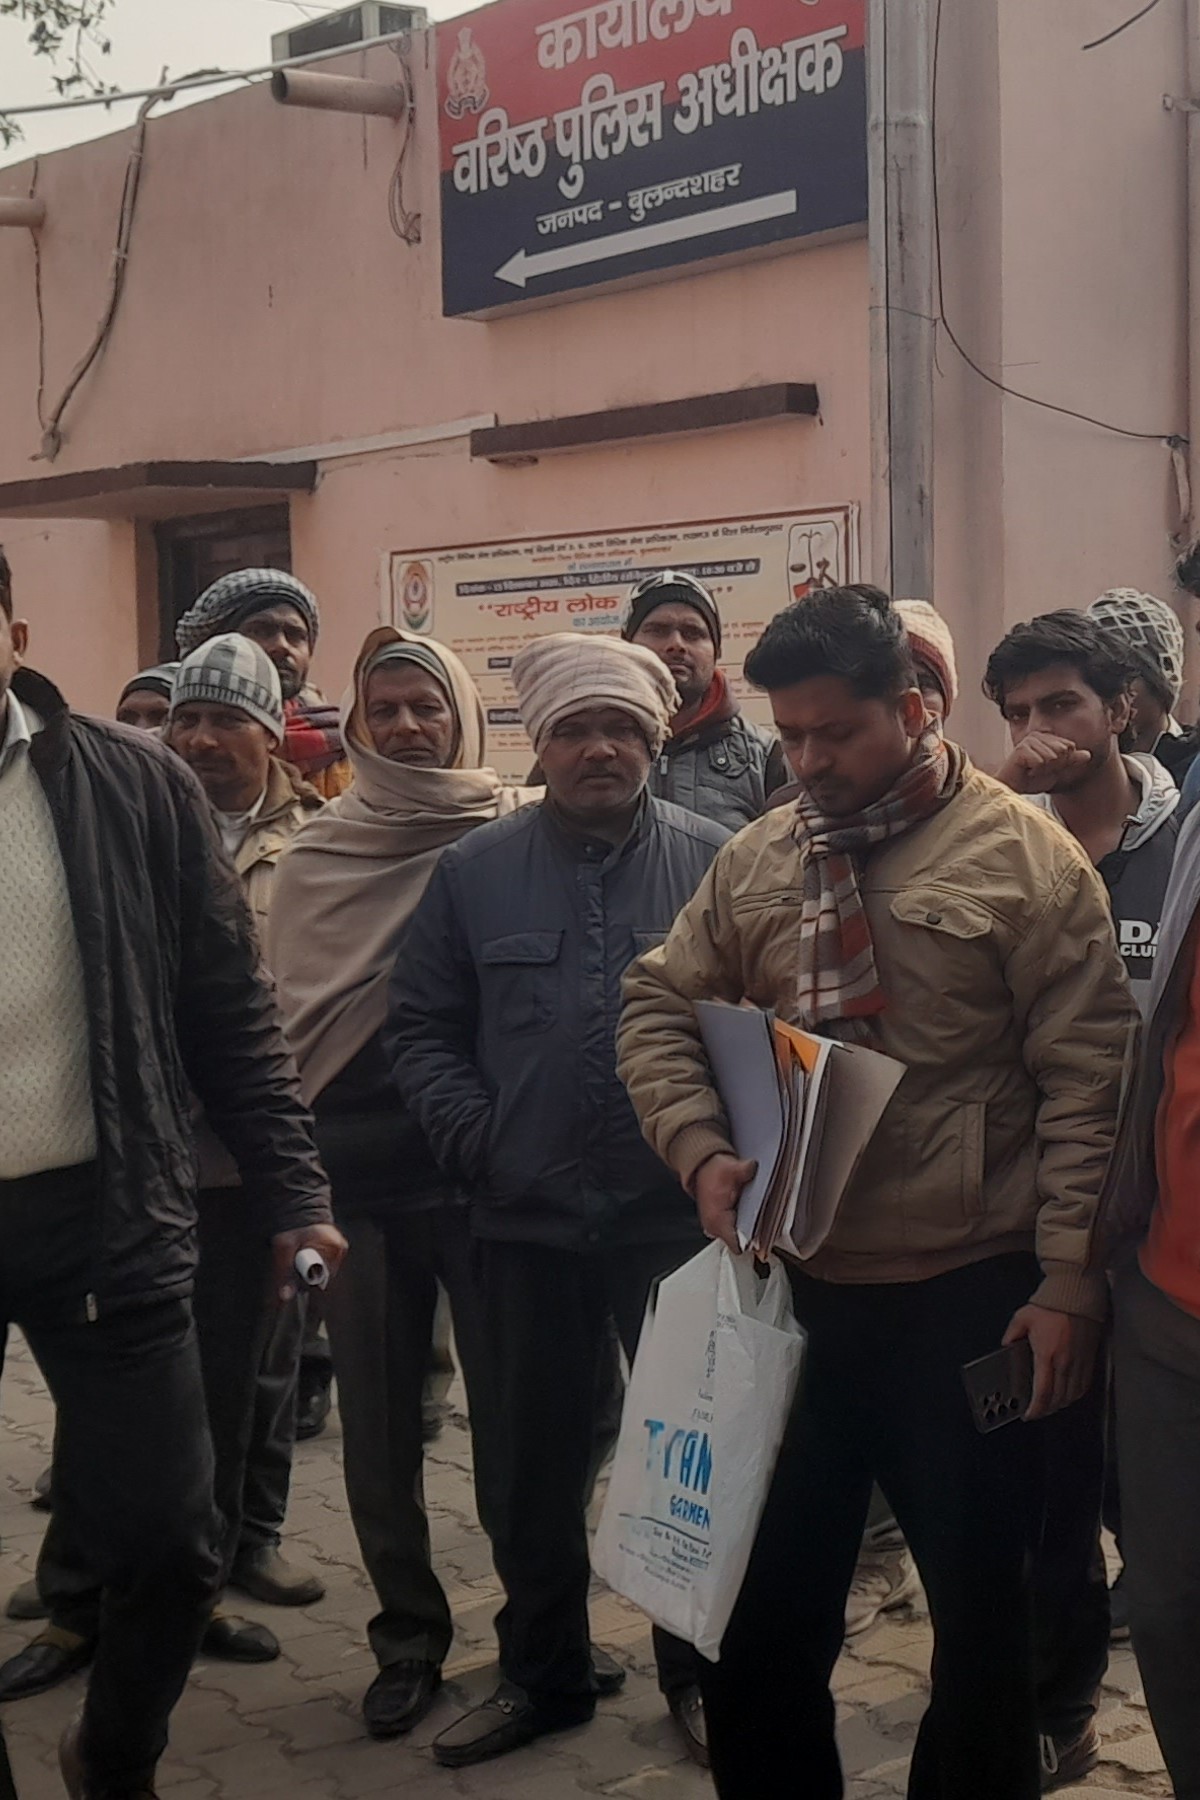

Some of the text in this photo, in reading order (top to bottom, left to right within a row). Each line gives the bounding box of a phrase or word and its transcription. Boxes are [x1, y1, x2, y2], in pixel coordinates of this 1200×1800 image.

[453, 25, 849, 200] वरिष्ठ पुलिस अधीक्षक
[536, 200, 604, 234] जनपद
[566, 593, 621, 613] लोक
